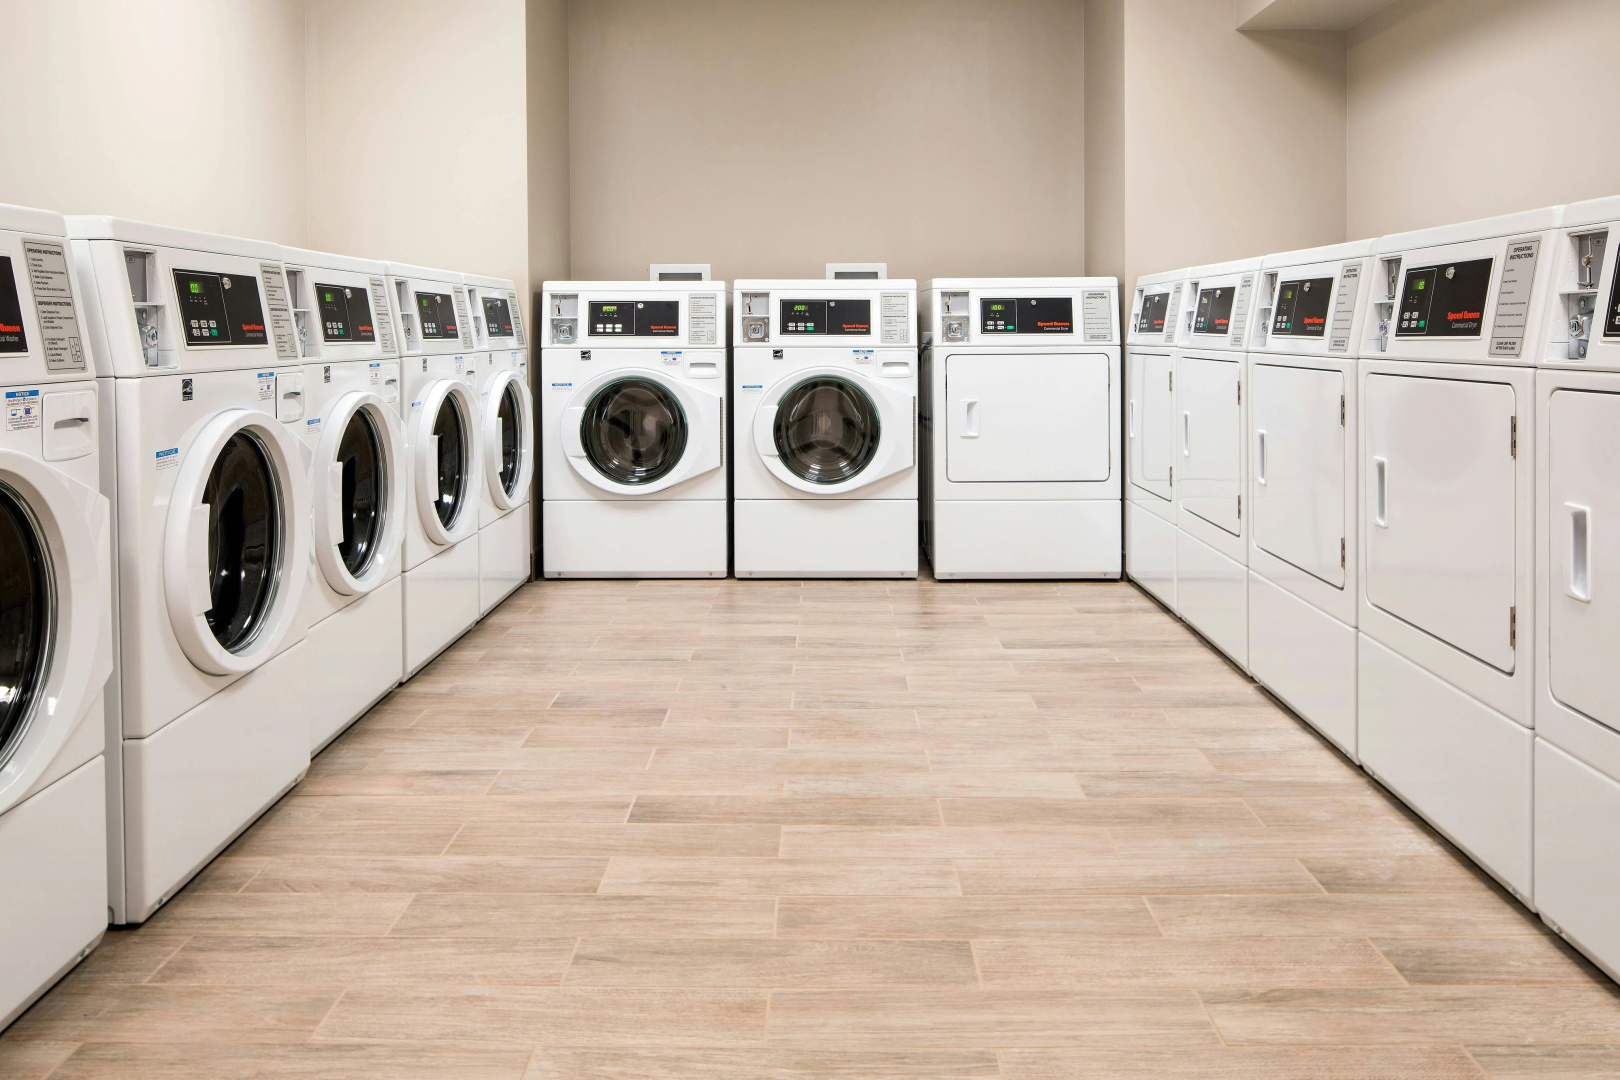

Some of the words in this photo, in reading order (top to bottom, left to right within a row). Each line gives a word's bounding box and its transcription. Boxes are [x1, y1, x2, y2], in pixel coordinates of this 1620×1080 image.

[1510, 252, 1534, 260] INSTRUCTIONS
[1447, 311, 1464, 321] Speed
[1463, 311, 1480, 319] Queen
